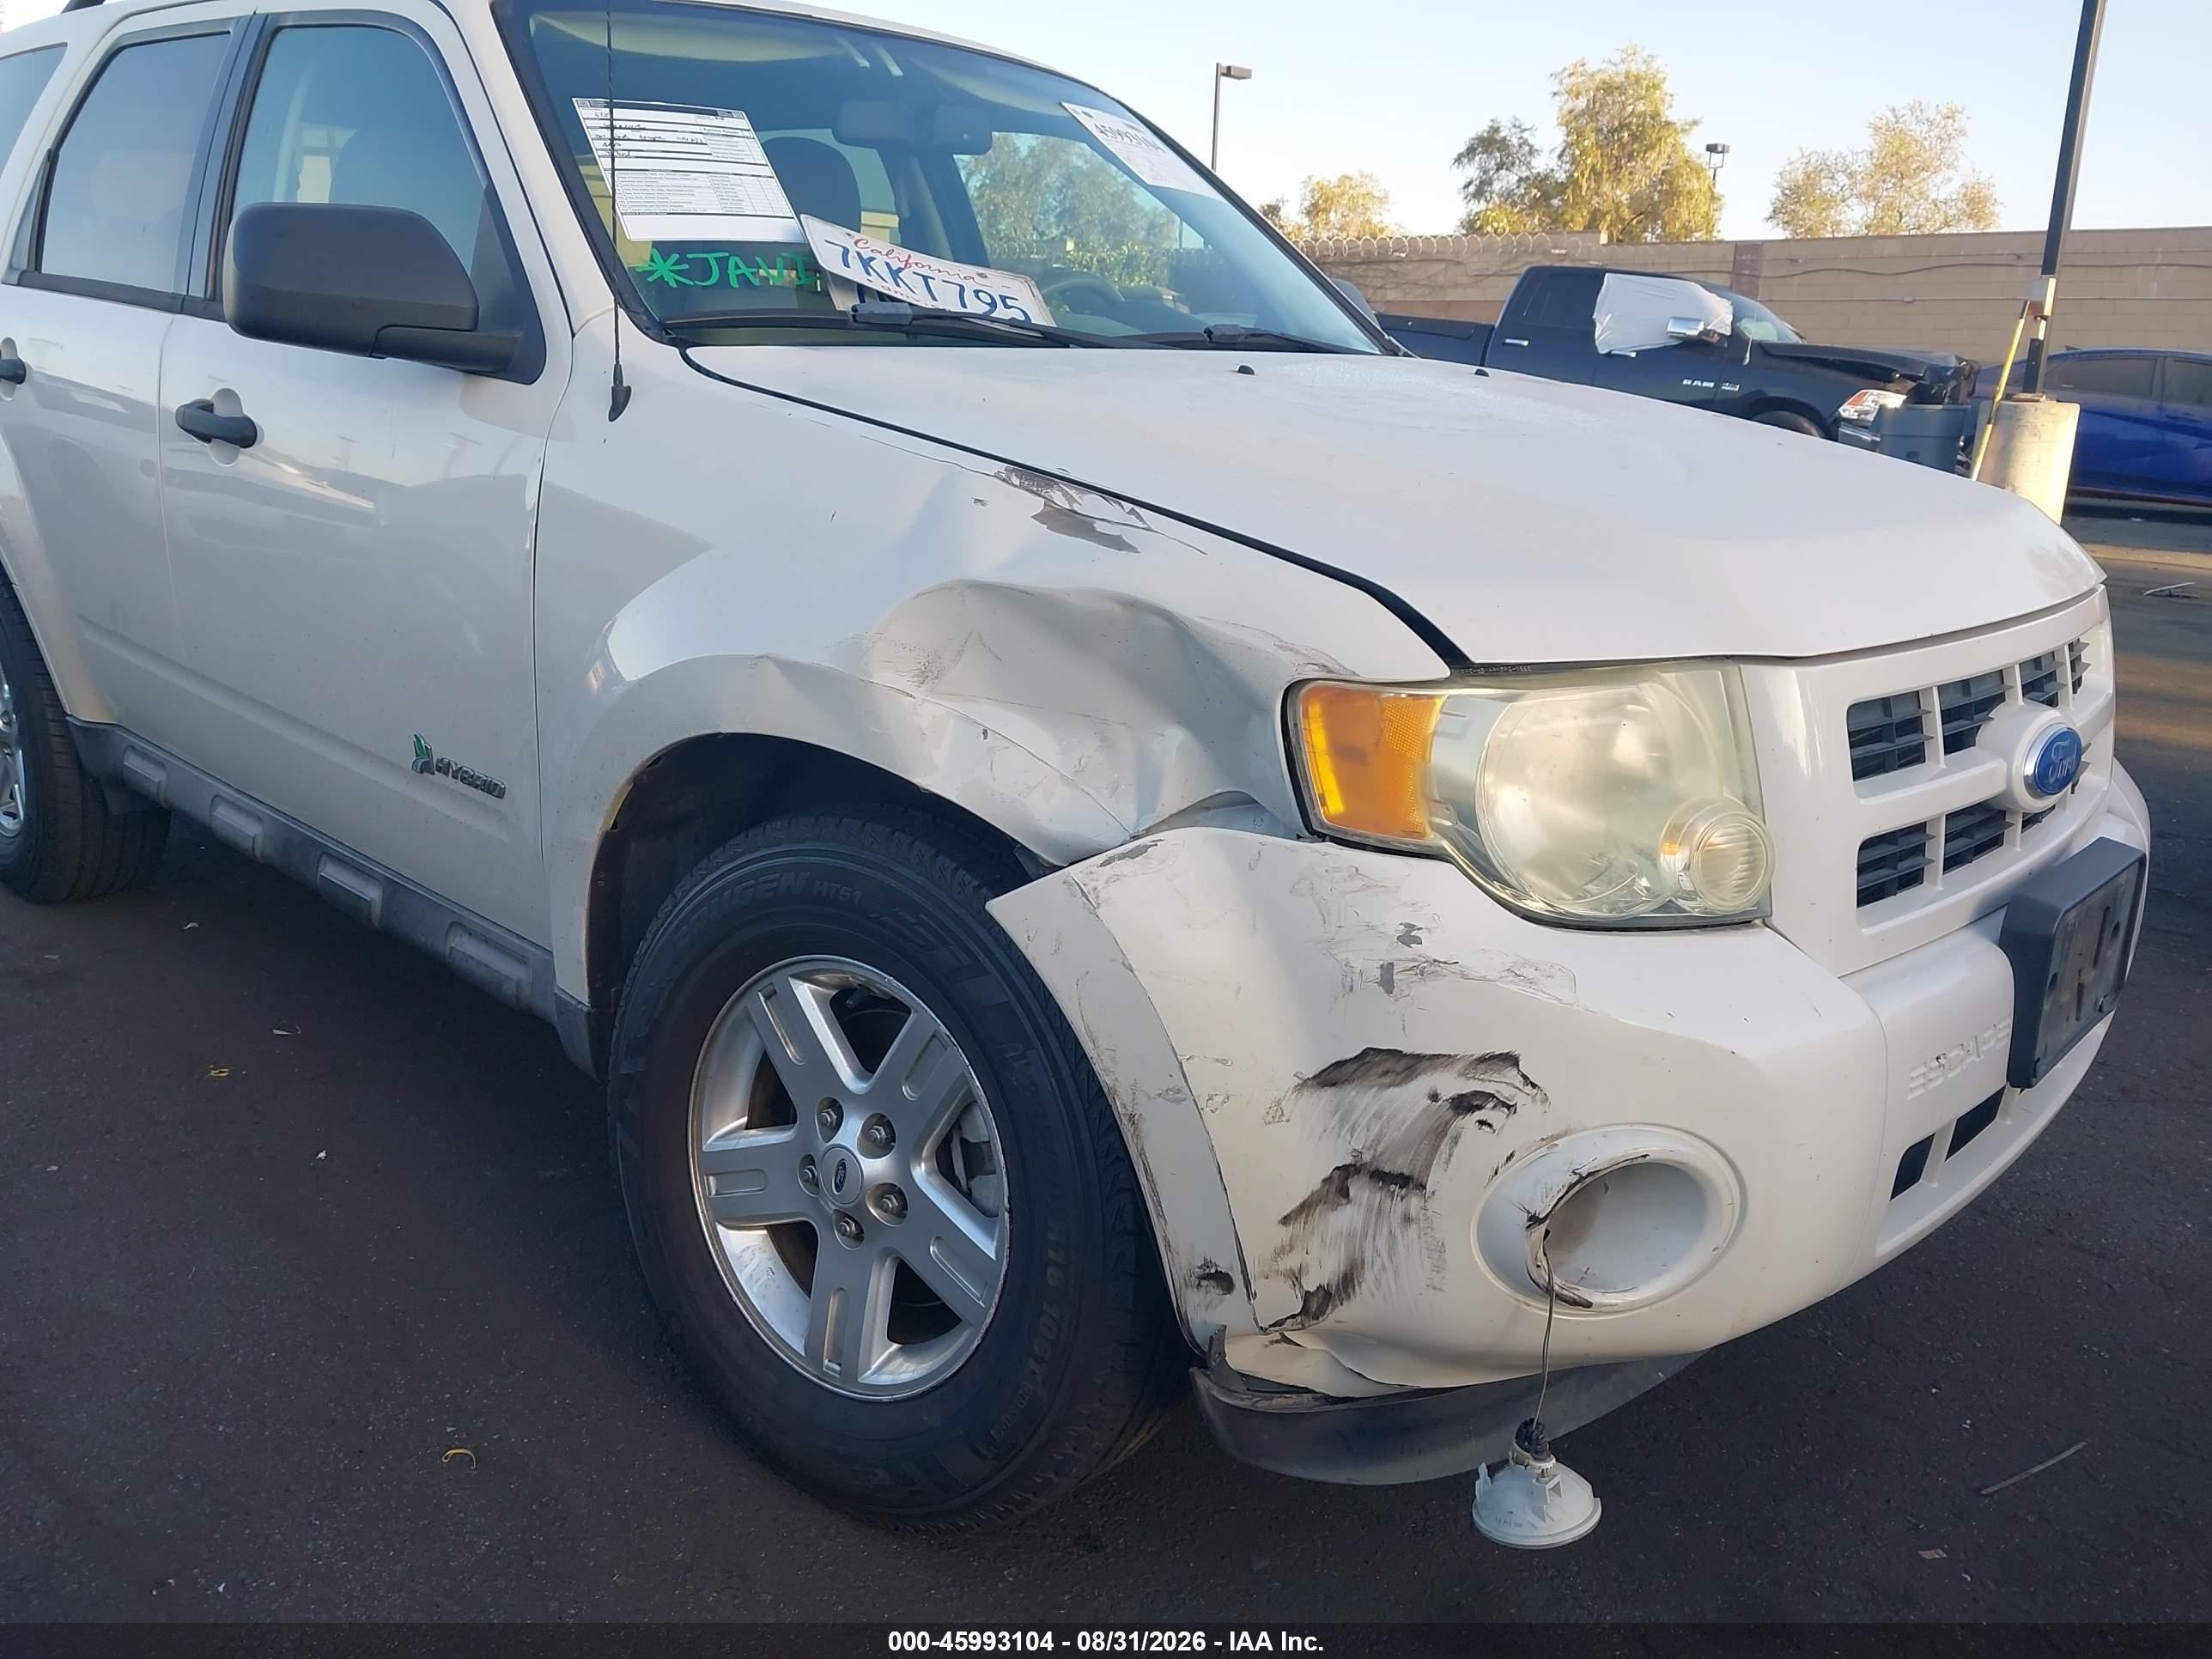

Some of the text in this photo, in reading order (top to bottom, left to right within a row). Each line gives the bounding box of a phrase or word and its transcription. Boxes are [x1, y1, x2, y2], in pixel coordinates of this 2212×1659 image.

[824, 239, 1031, 323] 7KKT795
[853, 237, 993, 289] California
[1682, 379, 1715, 388] RAM
[435, 757, 506, 799] HYBRID
[2048, 738, 2078, 783] Ford
